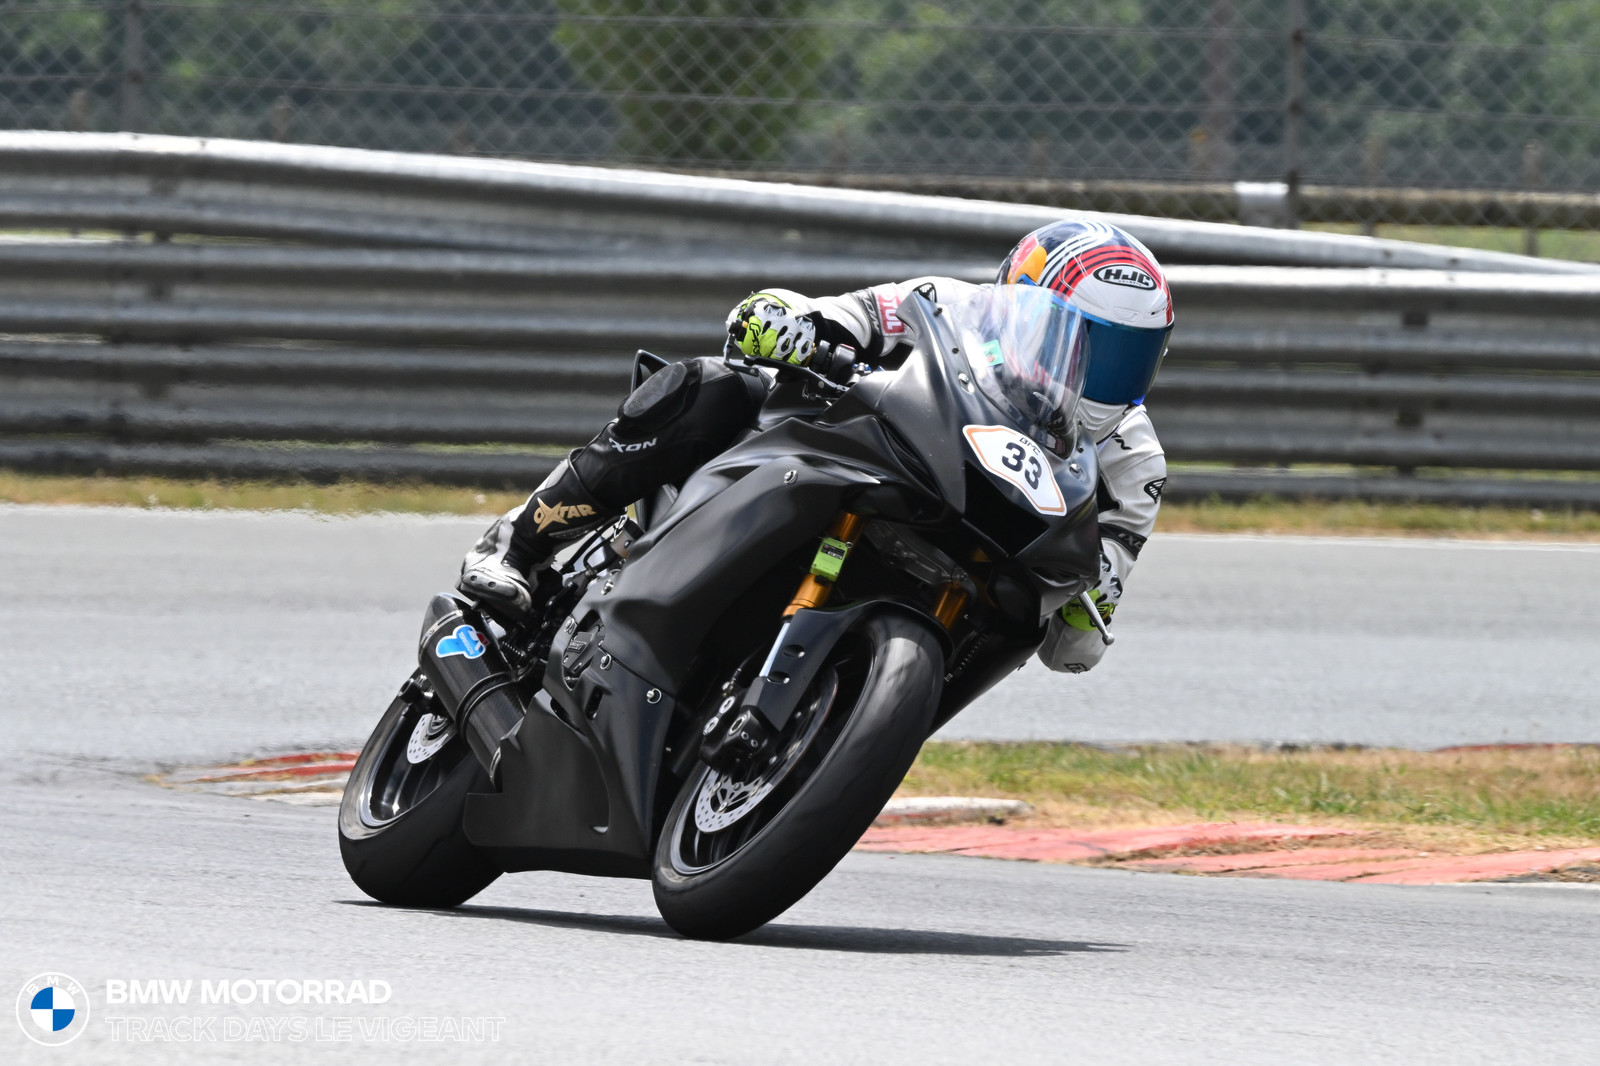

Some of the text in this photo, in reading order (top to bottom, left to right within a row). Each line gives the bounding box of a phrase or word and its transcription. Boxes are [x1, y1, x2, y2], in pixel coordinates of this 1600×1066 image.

[1103, 268, 1151, 287] HJC
[1001, 441, 1043, 490] 33
[533, 496, 597, 534] OXTAR
